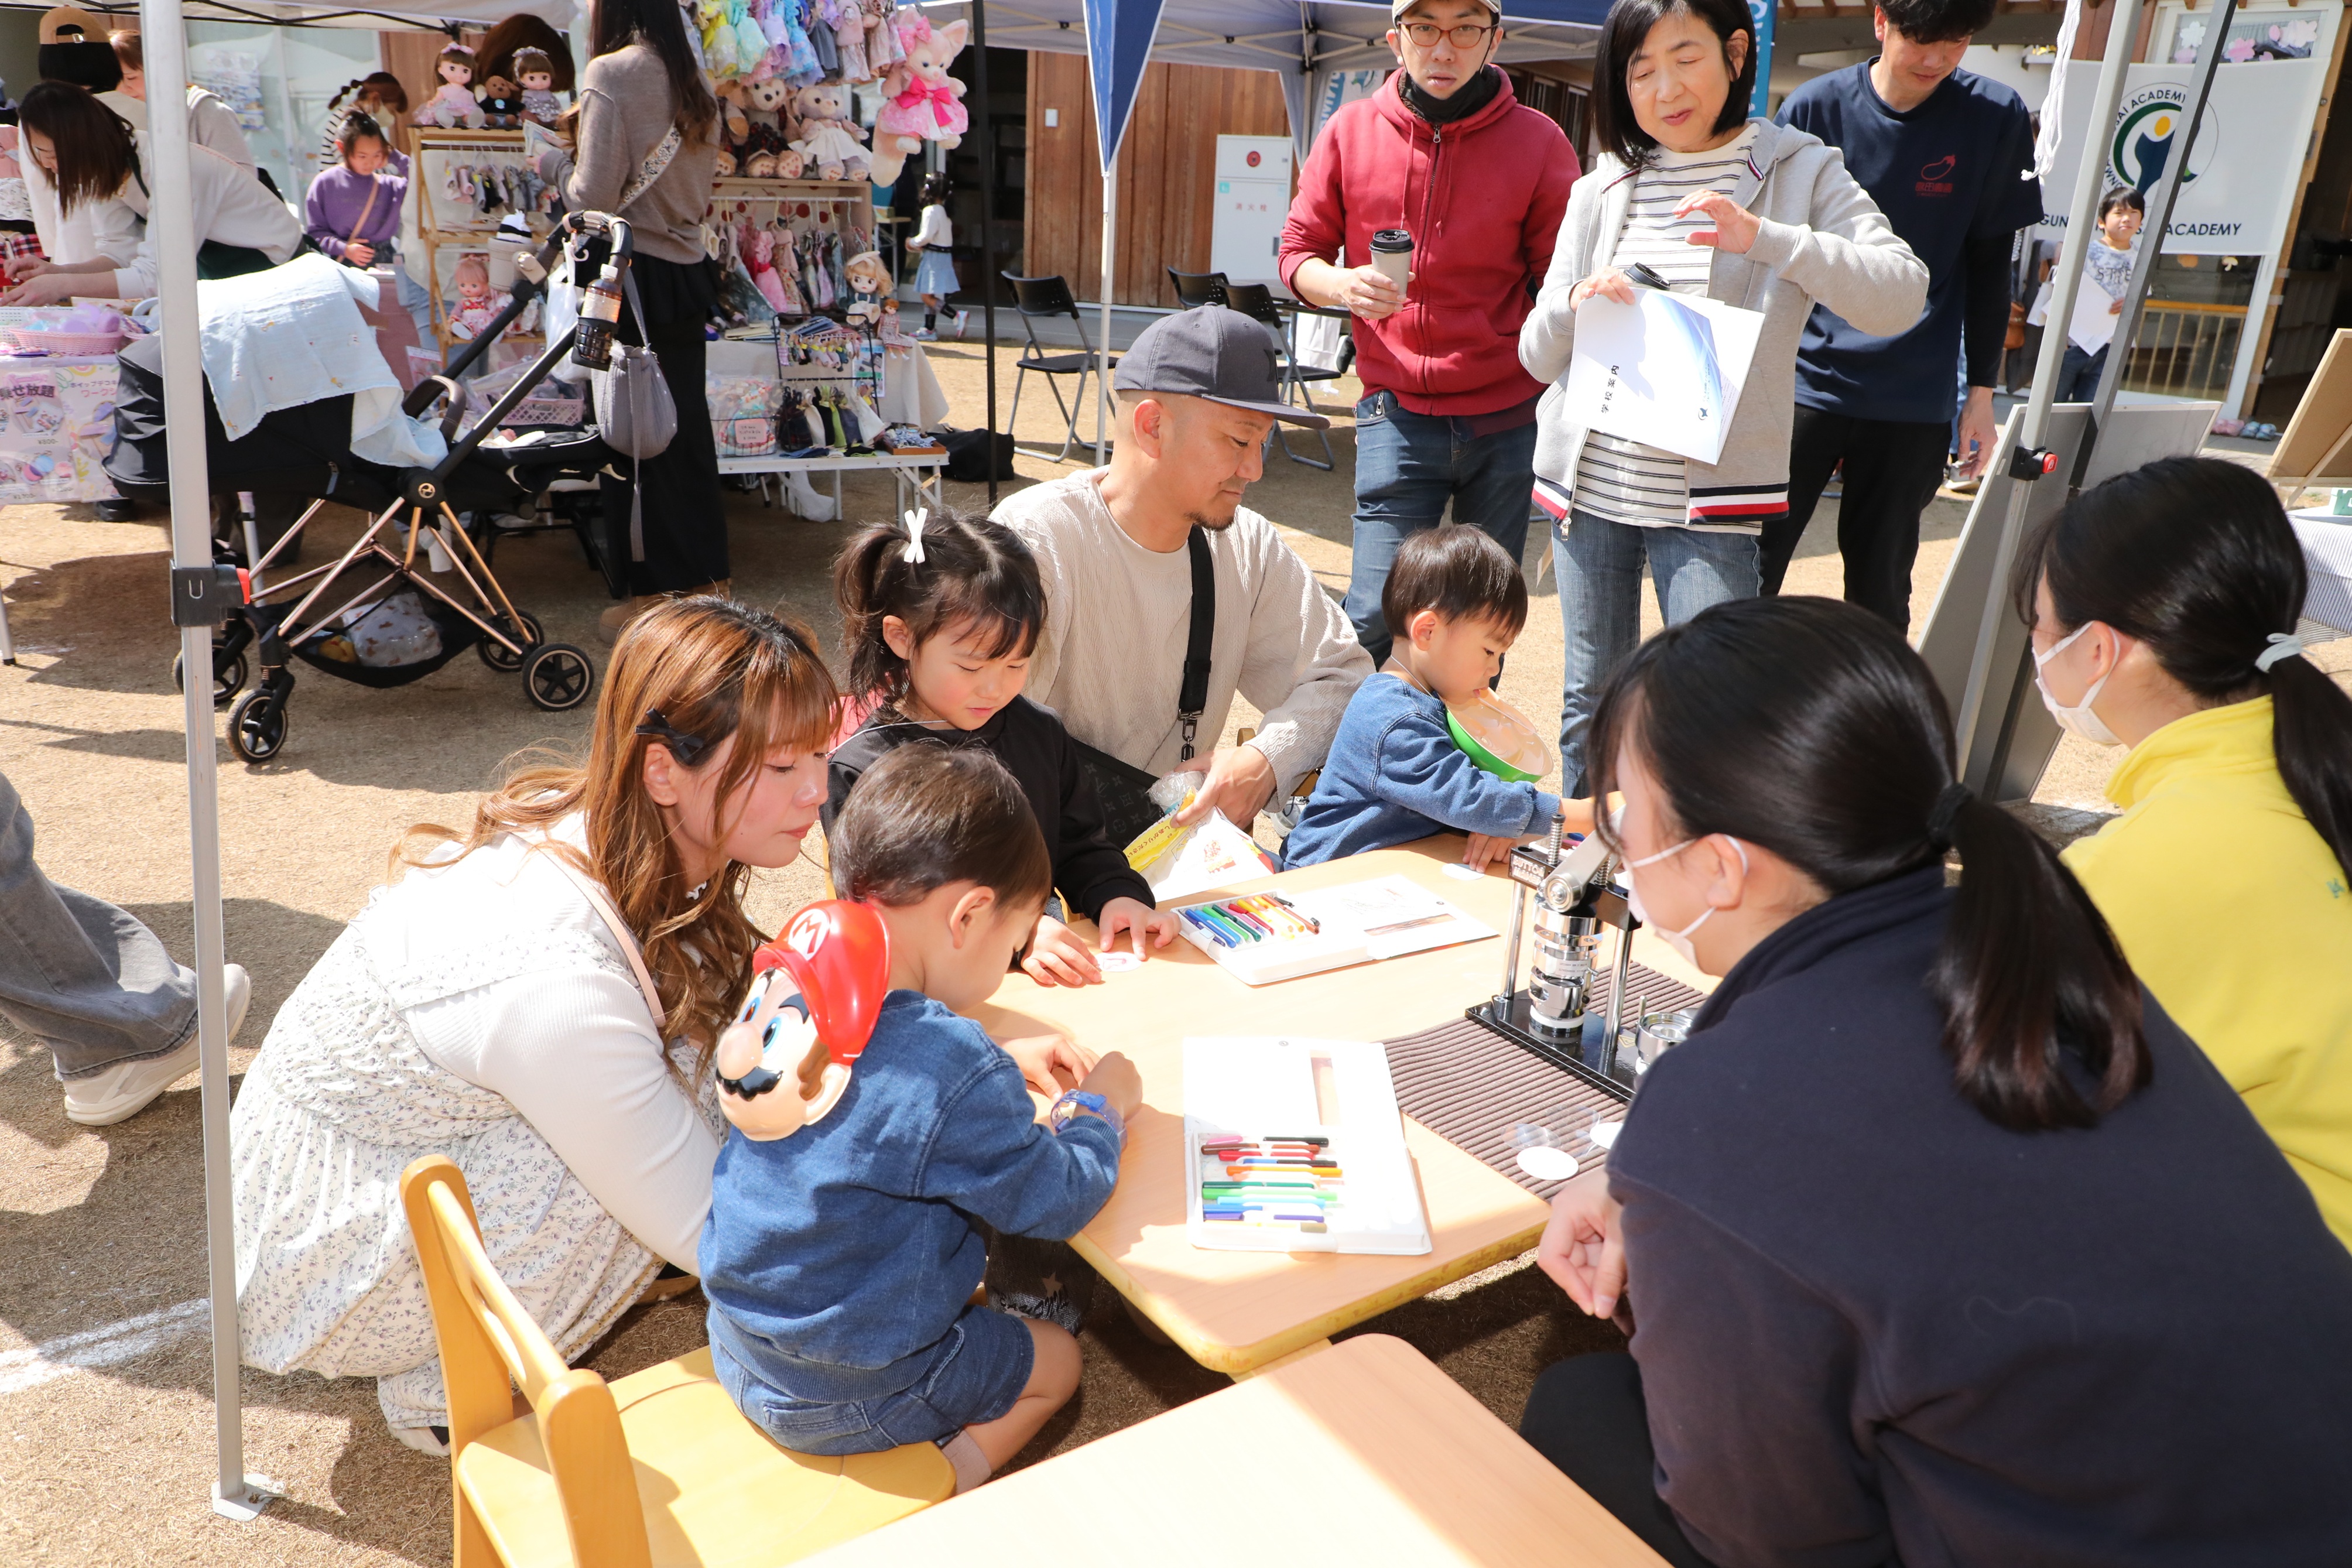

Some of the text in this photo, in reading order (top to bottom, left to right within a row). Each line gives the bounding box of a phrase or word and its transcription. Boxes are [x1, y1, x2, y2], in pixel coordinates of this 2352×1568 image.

[2040, 214, 2242, 236] GUN ACADEMY
[1601, 365, 1620, 414] 学校案内
[1512, 855, 1545, 877] BUTTON
